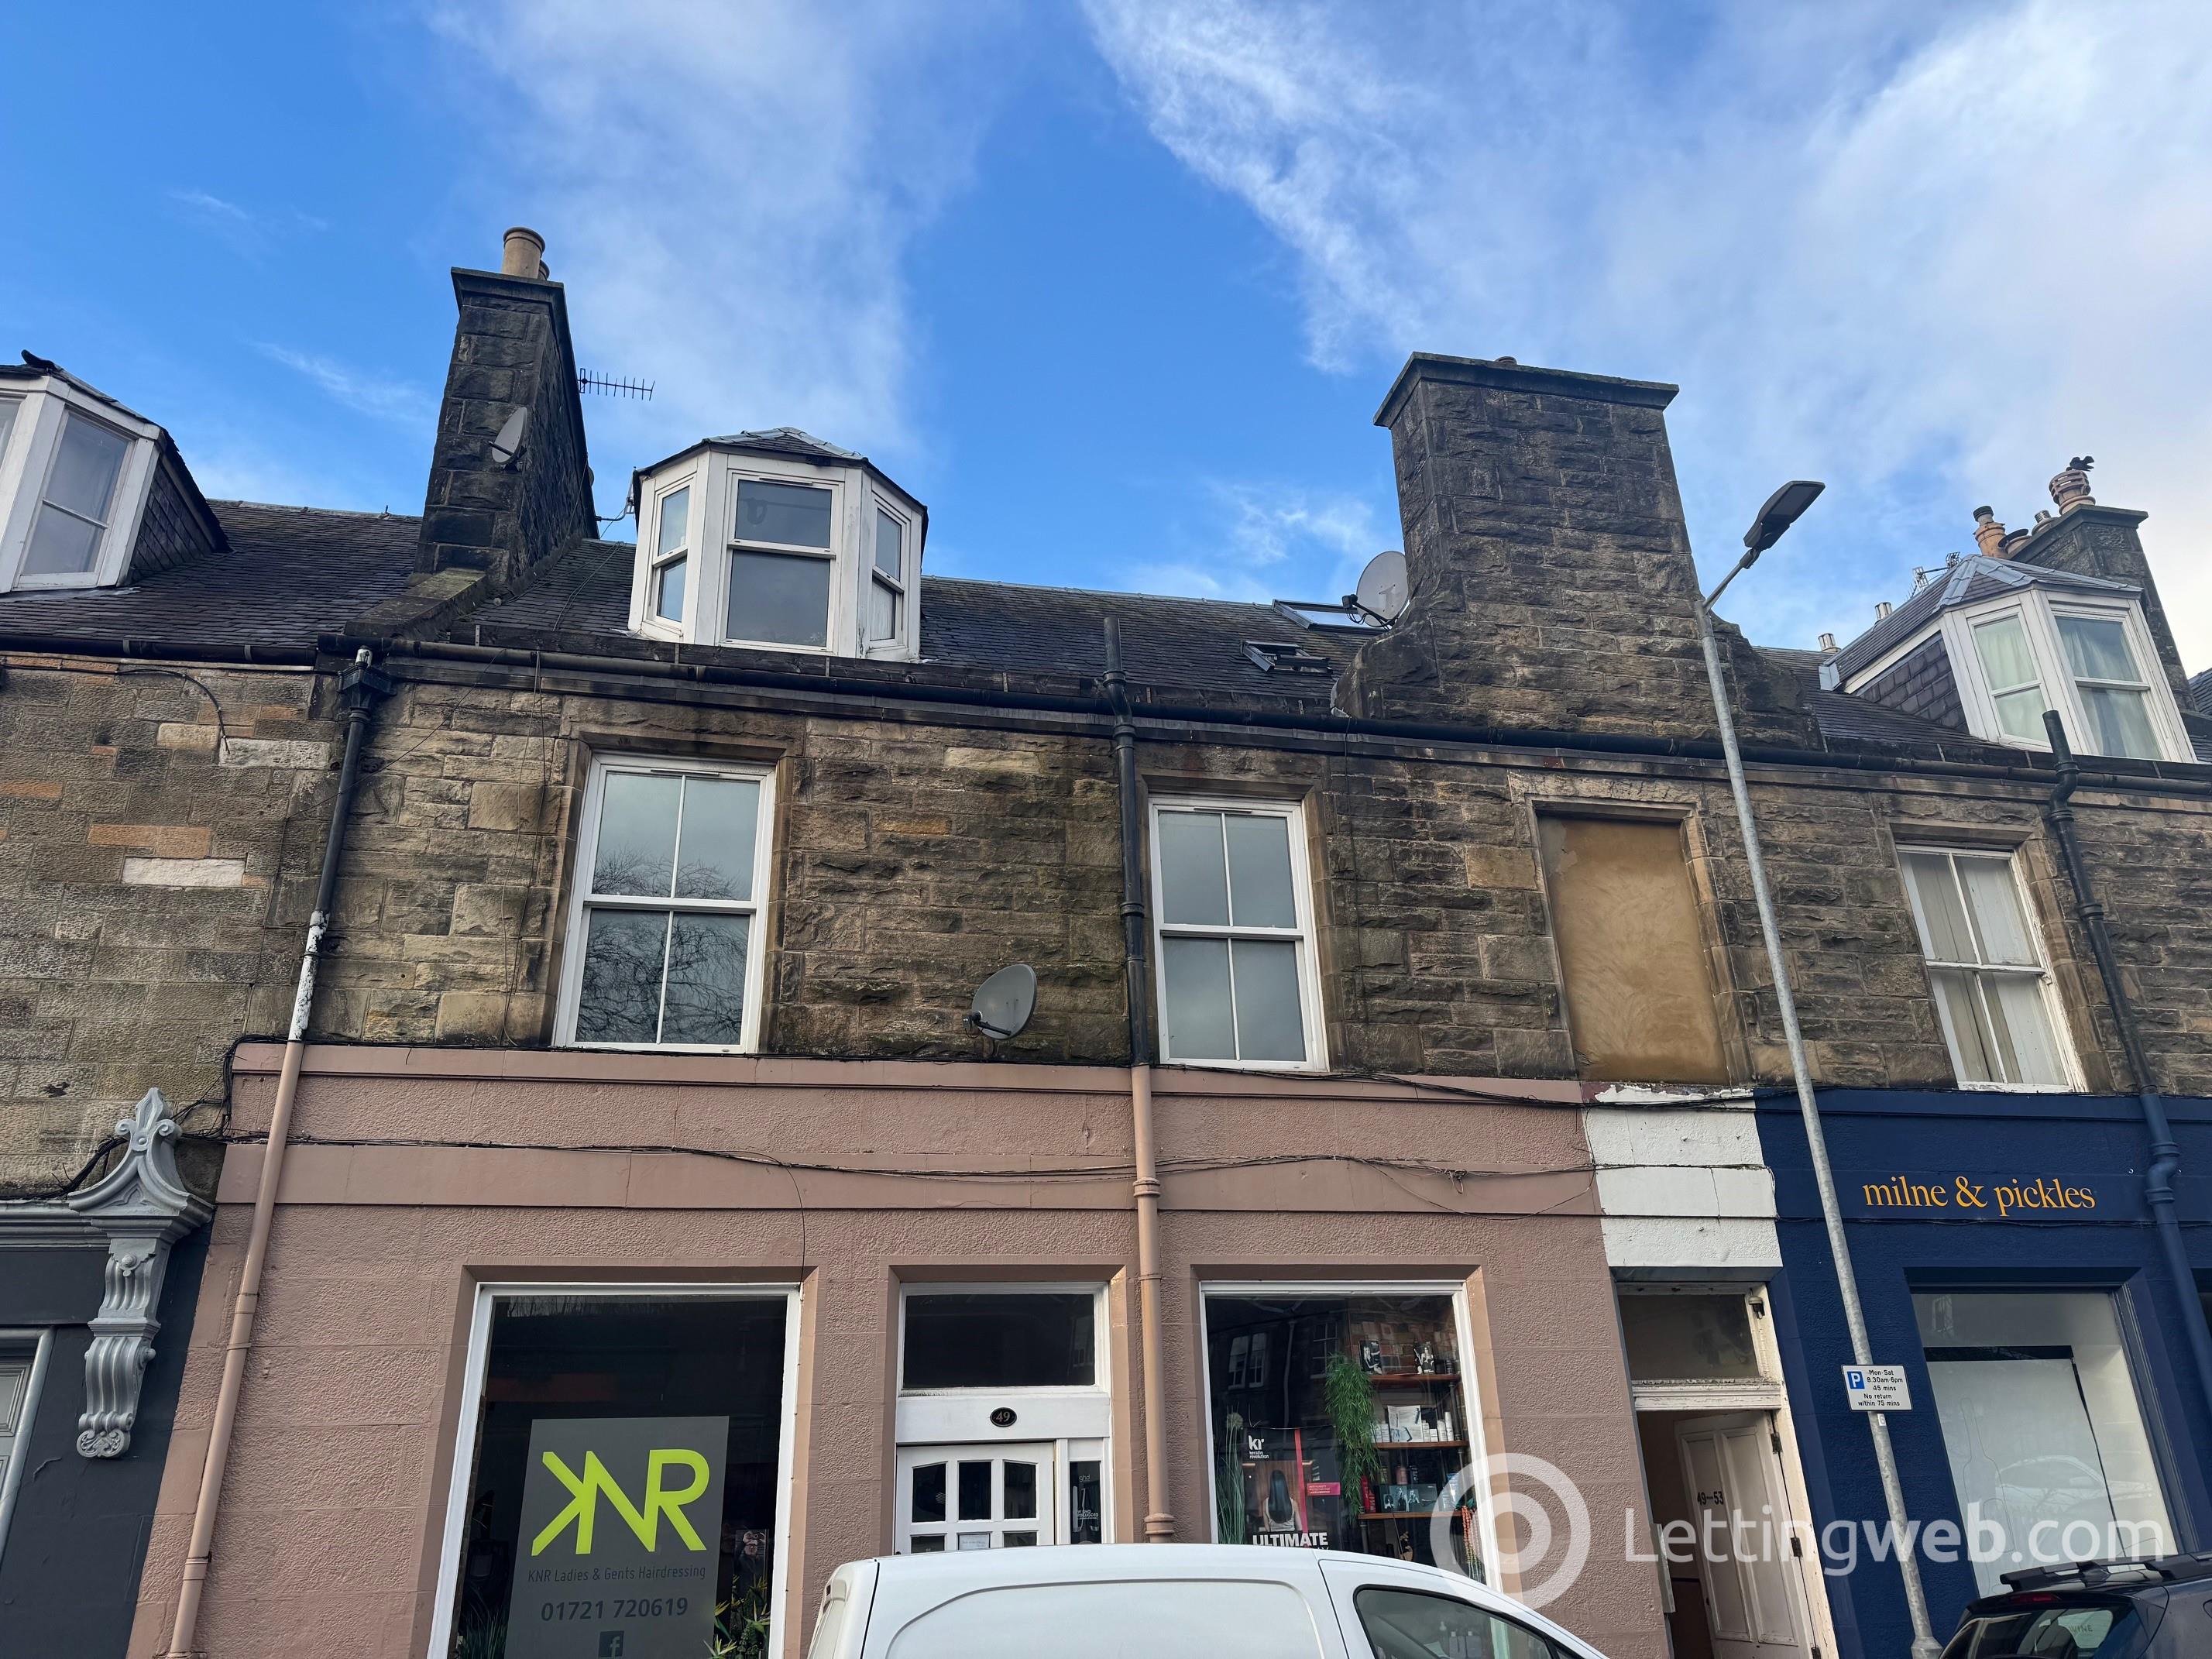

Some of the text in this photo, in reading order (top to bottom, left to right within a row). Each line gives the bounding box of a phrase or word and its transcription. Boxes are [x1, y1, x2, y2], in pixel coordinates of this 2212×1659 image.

[1862, 1175, 2096, 1217] milne & pickles
[1850, 1372, 1861, 1388] P
[996, 1411, 1011, 1422] 49
[1079, 1474, 1091, 1482] ghd
[531, 1448, 710, 1556] KNR
[1252, 1532, 1328, 1547] ULTIMATE
[527, 1565, 706, 1582] KNR Ladies & Gents Hairdressing
[541, 1597, 689, 1621] 01721 720619
